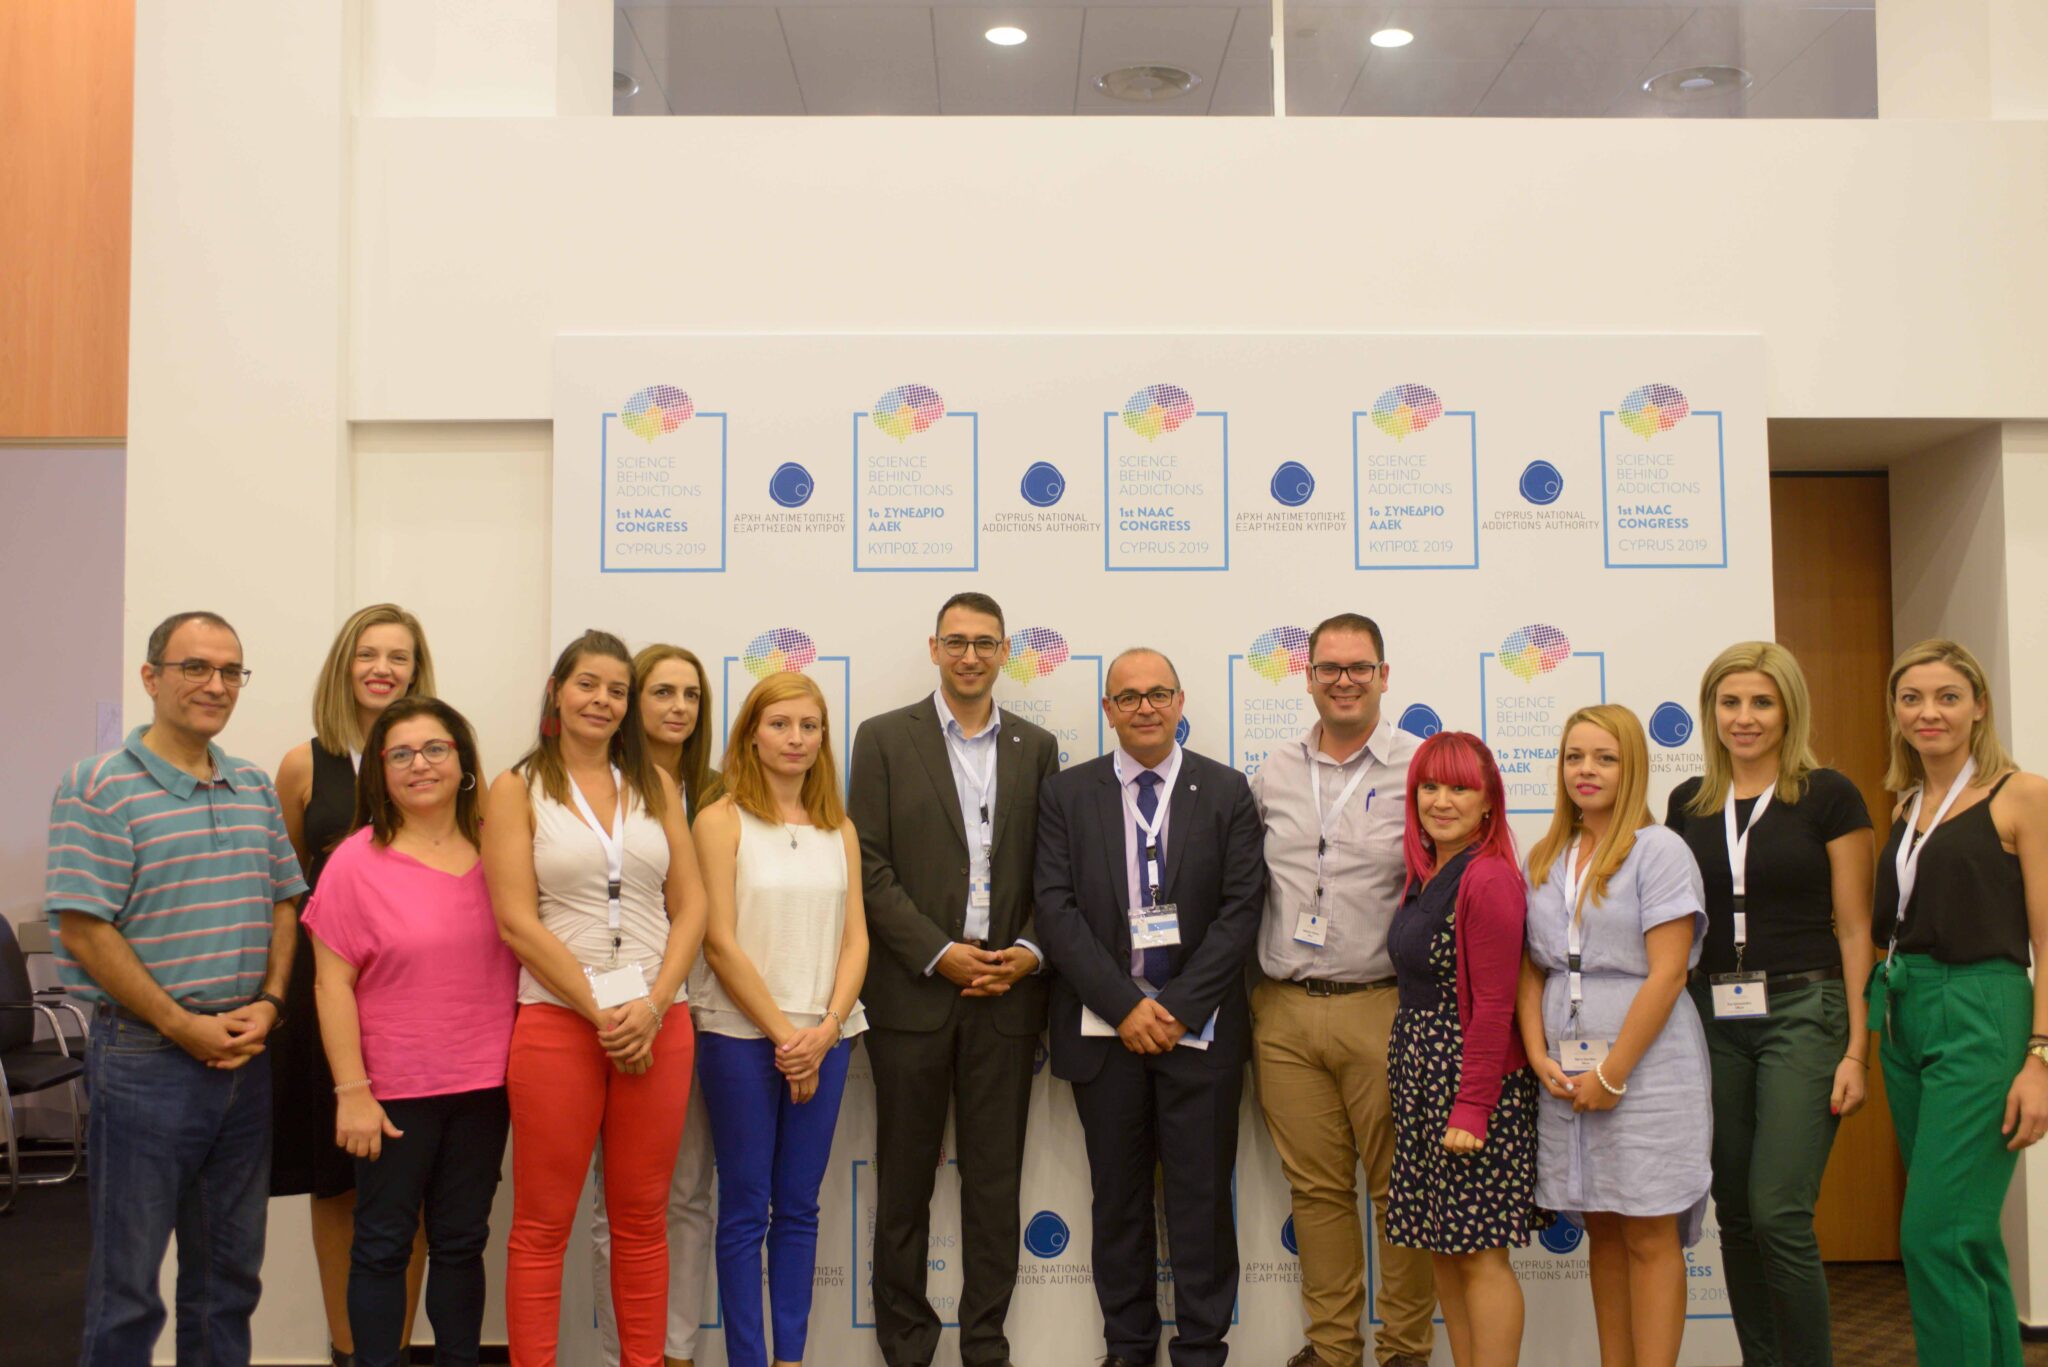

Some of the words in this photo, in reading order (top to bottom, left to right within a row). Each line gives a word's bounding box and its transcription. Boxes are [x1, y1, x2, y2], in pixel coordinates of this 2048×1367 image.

[616, 456, 676, 468] SCIENCE
[868, 456, 927, 468] SCIENCE
[1119, 456, 1177, 468] SCIENCE
[1368, 455, 1426, 466] SCIENCE
[1616, 454, 1674, 466] SCIENCE
[616, 470, 669, 482] BEHIND
[868, 470, 921, 482] BEHIND
[1119, 470, 1172, 482] BEHIND
[1368, 469, 1420, 480] BEHIND
[1616, 468, 1668, 480] BEHIND
[616, 484, 702, 496] ADDICTIONS
[868, 484, 953, 496] ADDICTIONS
[1119, 484, 1204, 496] ADDICTIONS
[1368, 483, 1452, 495] ADDICTIONS
[1616, 482, 1700, 494] ADDICTIONS
[616, 508, 631, 518] 1st
[634, 508, 672, 518] NAAC
[884, 508, 944, 518] ΣΥΝΕΔΡΙΟ
[1120, 507, 1134, 518] 1st
[1138, 507, 1174, 518] NAAC
[1384, 506, 1444, 516] ΣΥΝΕΔΡΙΟ
[1494, 511, 1533, 520] CYPRUS
[1536, 511, 1586, 519] NATIONAL
[1618, 505, 1632, 516] 1st
[1636, 505, 1672, 515] NAAC
[734, 513, 760, 522] ΑΡΧΗ
[765, 513, 846, 522] ΑΝΤΙΜΕΤΩΠΙΣΗΣ
[995, 512, 1034, 522] CYPRUS
[1038, 512, 1087, 522] NATIONAL
[1236, 512, 1263, 521] ΑΡΧΗ
[1267, 512, 1346, 521] ΑΝΤΙΜΕΤΩΠΙΣΗΣ
[616, 522, 688, 532] CONGRESS
[734, 523, 801, 533] ΕΞΑΡΤΗΣΕΩΝ
[806, 523, 846, 533] ΚΥΠΡΟΥ
[868, 522, 901, 532] ΑΑΕΚ
[982, 523, 1042, 532] ADDICTIONS
[1046, 523, 1100, 532] AUTHORITY
[1120, 521, 1191, 531] CONGRESS
[1236, 522, 1303, 531] ΕΞΑΡΤΗΣΕΩΝ
[1307, 522, 1347, 531] ΚΥΠΡΟΥ
[1369, 520, 1402, 530] ΑΑΕΚ
[1482, 521, 1541, 530] ADDICTIONS
[1545, 521, 1599, 530] AUTHORITY
[1618, 518, 1689, 529] CONGRESS
[616, 542, 673, 555] CYPRUS
[676, 542, 706, 555] 2019
[868, 542, 919, 554] ΚΥΠΡΟΣ
[923, 542, 953, 554] 2019
[1120, 541, 1175, 554] CYPRUS
[1179, 541, 1209, 554] 2019
[1369, 540, 1420, 553] ΚΥΠΡΟΣ
[1424, 540, 1454, 552] 2019
[1618, 539, 1674, 552] CYPRUS
[1677, 539, 1708, 551] 2019
[1000, 700, 1052, 712] CIENCE
[1244, 698, 1304, 710] SCIENCE
[1496, 696, 1555, 709] SCIENCE
[1245, 713, 1297, 725] BEHIND
[1497, 711, 1549, 723] BEHIND
[1497, 725, 1563, 737] ADDICTIO
[1245, 751, 1259, 761] 1st
[1513, 748, 1559, 759] ΣΥΝΕΔΡ
[1667, 753, 1703, 762] NATION
[1504, 784, 1548, 796] ΥΠΡΟΣ
[1017, 1265, 1038, 1274] RUS
[1246, 1263, 1273, 1272] ΑΡΧΗ
[1513, 1260, 1552, 1269] CYPRUS
[1050, 1275, 1093, 1285] AUTHOR
[1514, 1271, 1561, 1280] DICTIONS
